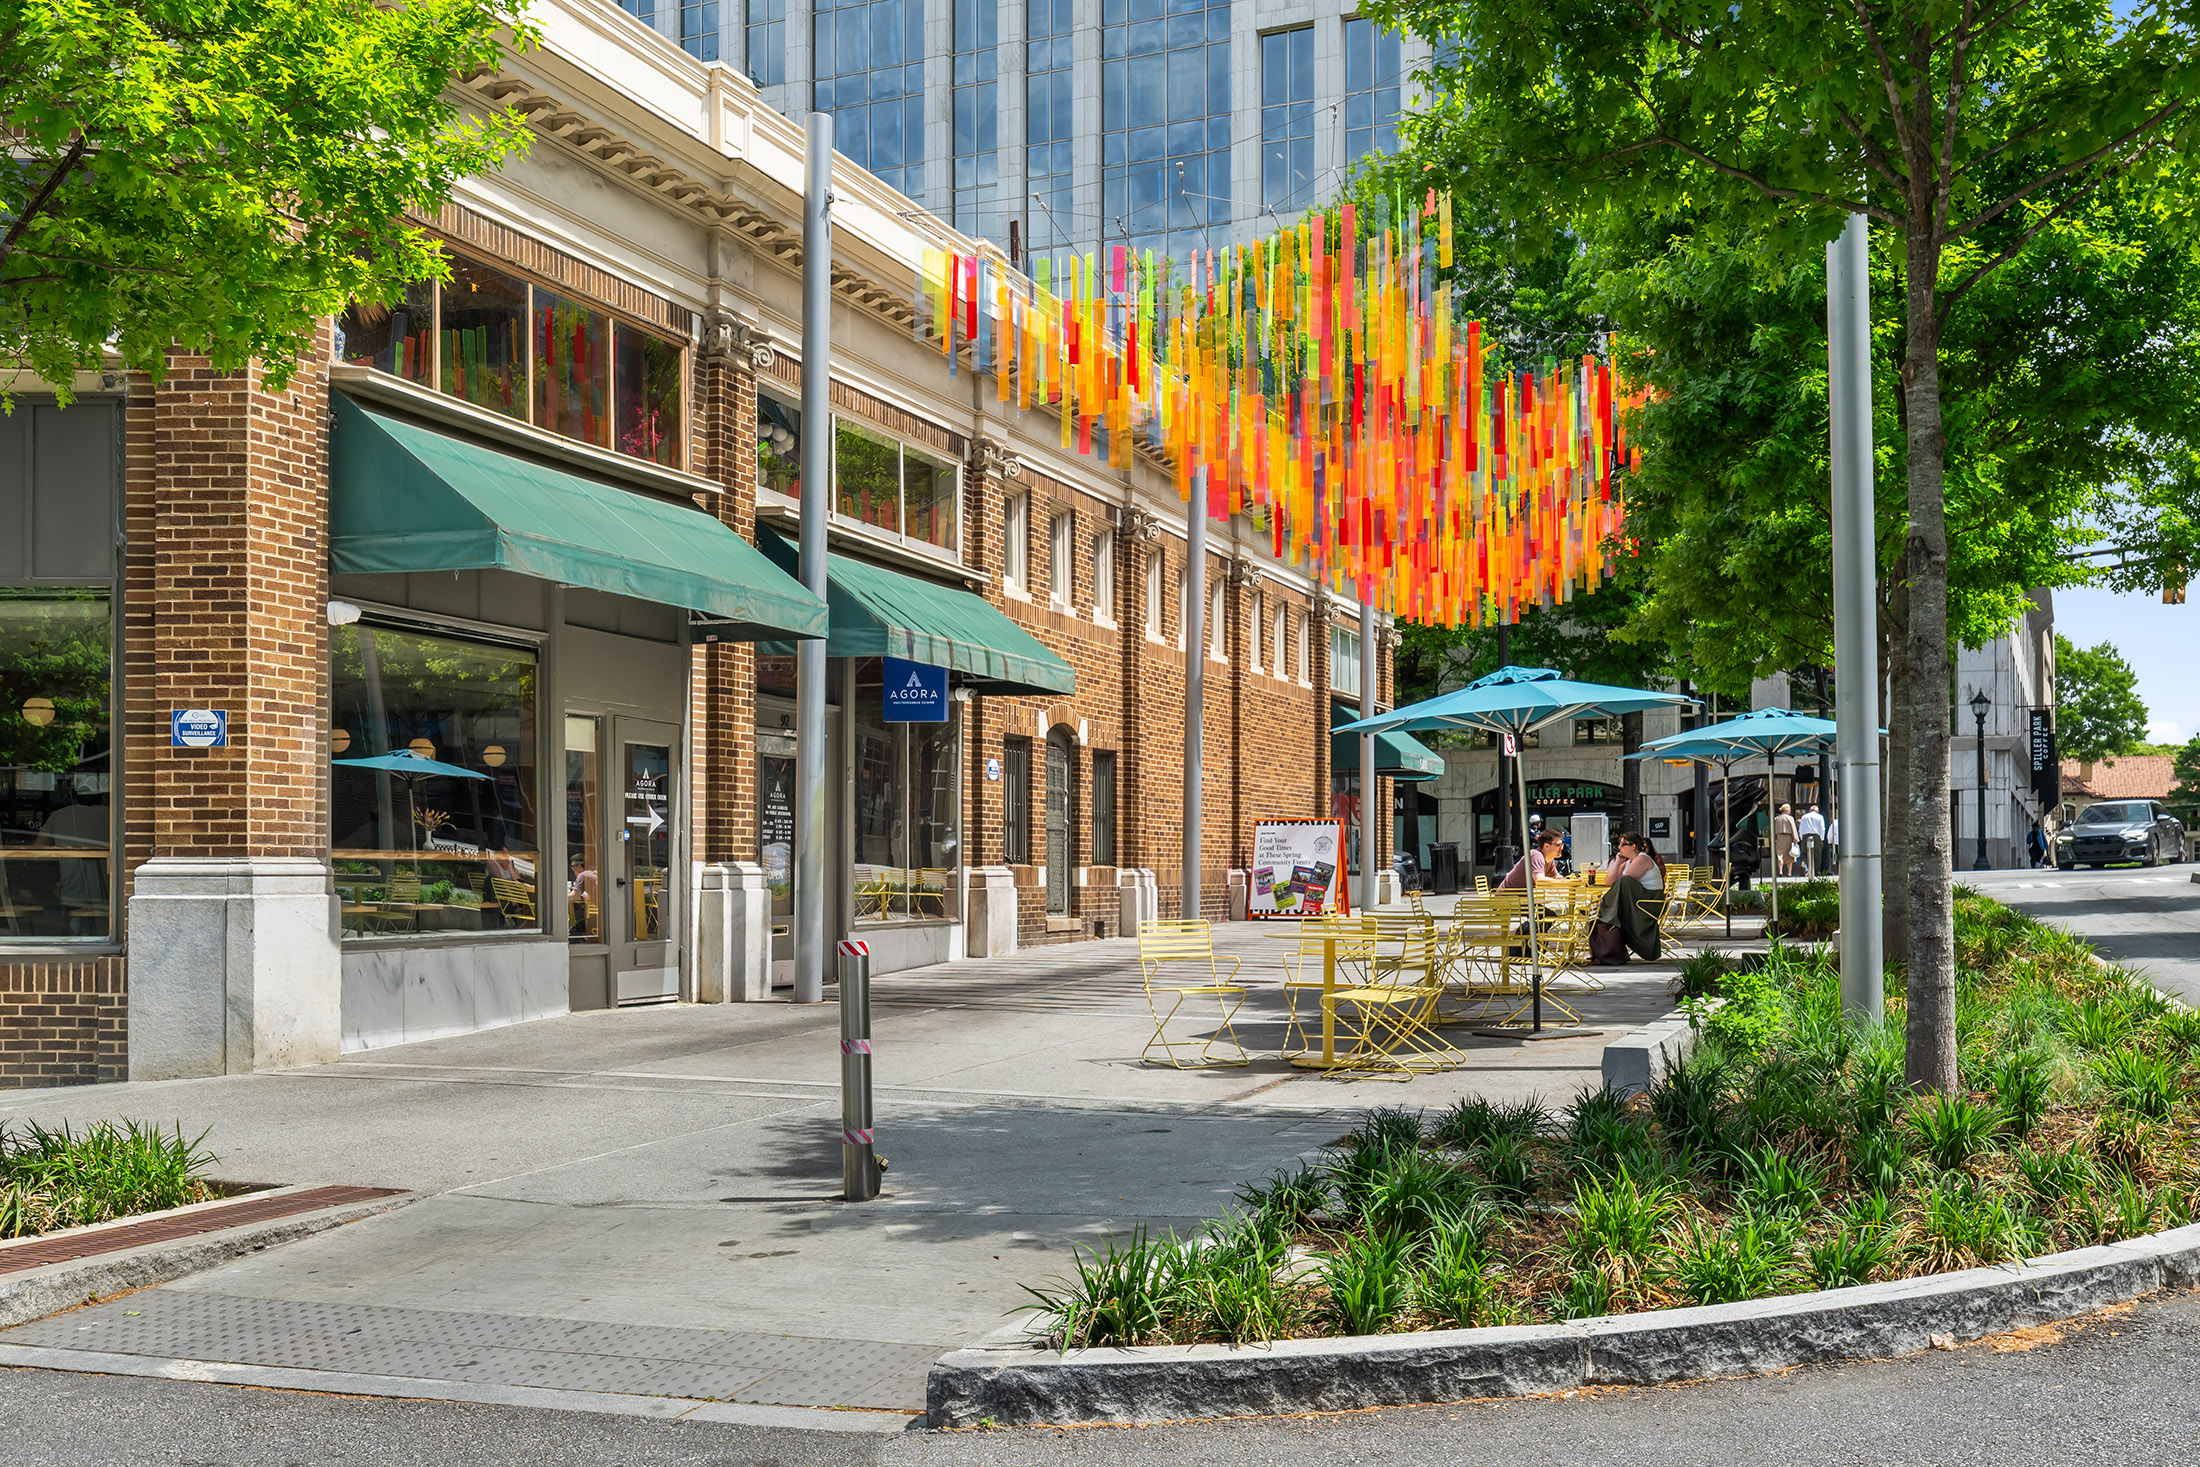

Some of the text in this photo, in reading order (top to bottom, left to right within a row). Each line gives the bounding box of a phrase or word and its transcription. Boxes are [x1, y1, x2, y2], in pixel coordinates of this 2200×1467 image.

[890, 690, 938, 699] AGORA
[780, 714, 790, 727] 92
[2033, 716, 2042, 770] SPILLER PARK
[1527, 787, 1603, 799] ILLER PARK
[768, 871, 783, 879] OPEN
